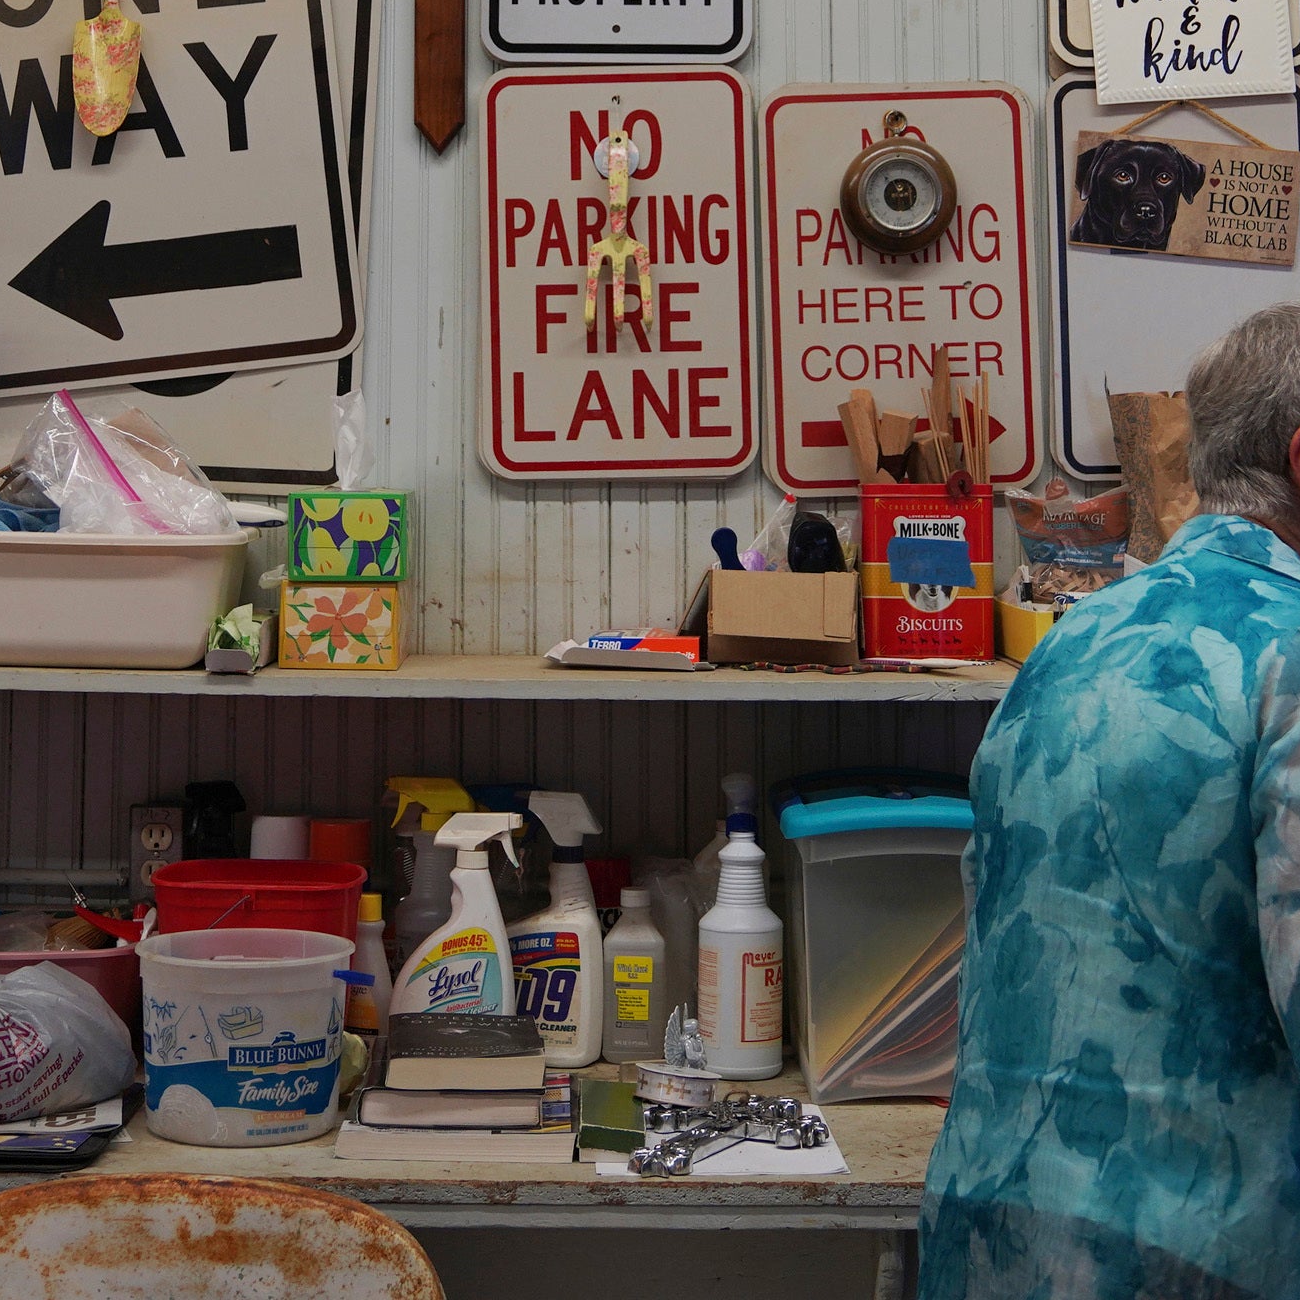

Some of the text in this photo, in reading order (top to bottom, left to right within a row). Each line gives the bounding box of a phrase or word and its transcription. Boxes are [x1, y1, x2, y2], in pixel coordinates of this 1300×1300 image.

[1181, 5, 1201, 36] &
[1144, 14, 1243, 83] kind
[570, 110, 662, 180] NO
[1211, 159, 1294, 182] A HOUSE
[1224, 180, 1279, 195] IS NOT A
[1207, 192, 1290, 220] HOME
[796, 203, 1001, 267] PANG
[1204, 230, 1288, 251] BLACK LAB
[1207, 216, 1287, 234] WITHOUT A
[535, 282, 702, 354] FIRE
[798, 283, 1004, 325] HERE TO
[801, 342, 1004, 382] CORNER
[513, 367, 732, 442] LANE
[442, 936, 468, 952] BONUS
[518, 938, 540, 950] MORE
[541, 938, 552, 947] OZ.
[428, 960, 482, 997] Lysol
[540, 1024, 577, 1032] CLEANER
[235, 1049, 274, 1064] BLUE
[4, 1090, 32, 1109] start
[34, 1053, 63, 1092] saving!
[10, 1050, 85, 1120] and full of perks!
[237, 1076, 319, 1107] Family Size
